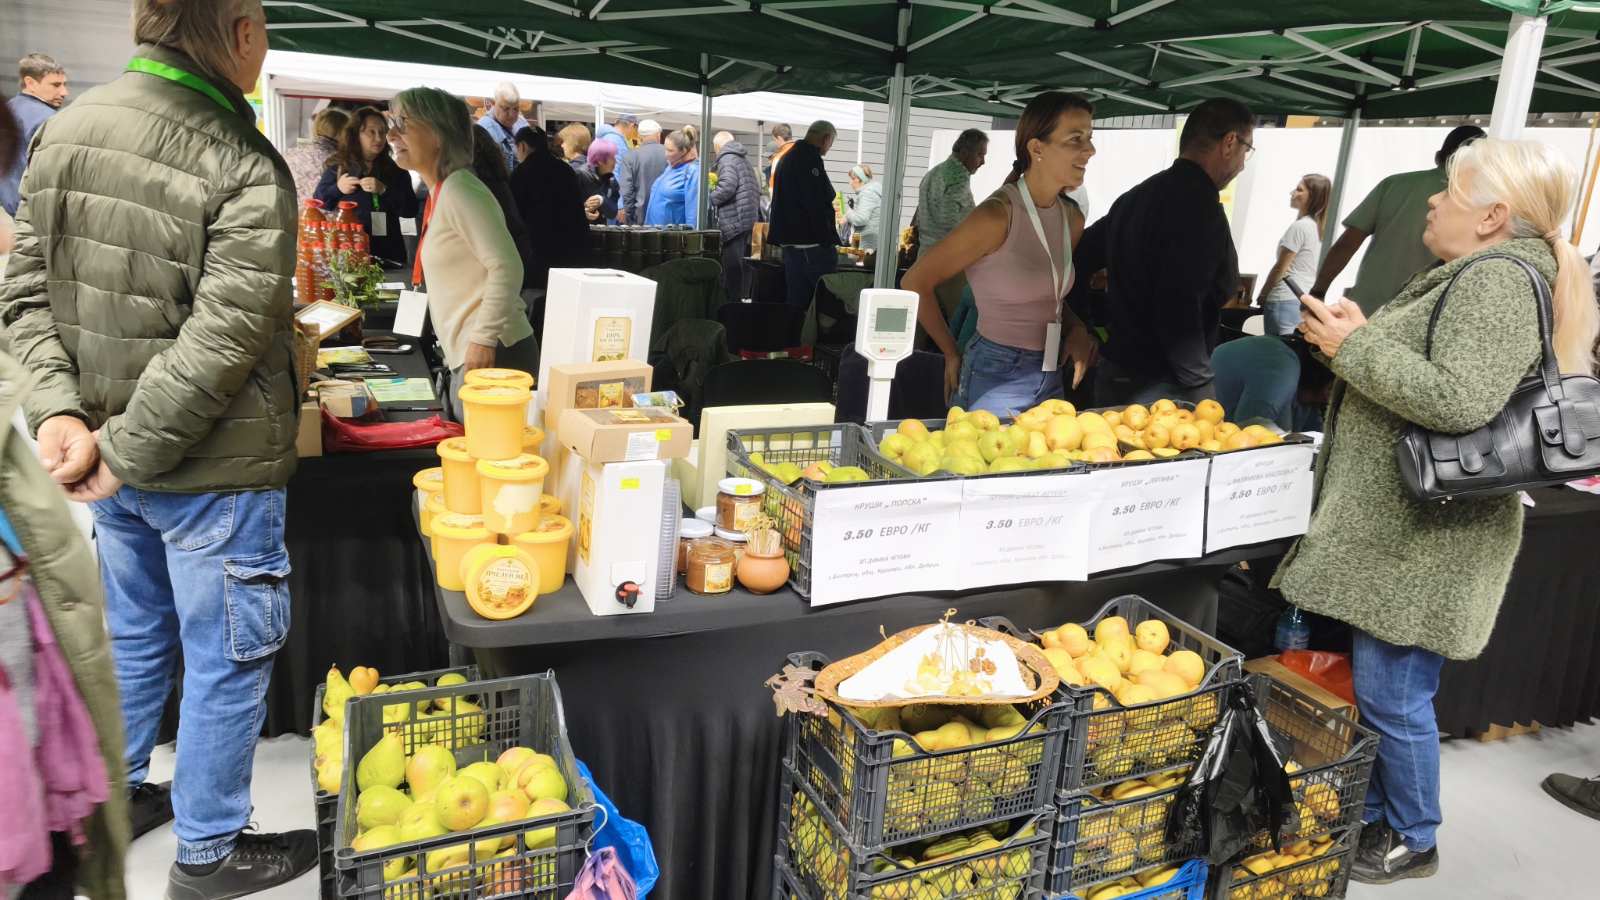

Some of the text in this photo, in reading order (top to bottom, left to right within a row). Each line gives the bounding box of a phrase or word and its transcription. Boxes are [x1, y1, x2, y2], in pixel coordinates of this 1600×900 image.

[1229, 489, 1252, 500] 3.50
[1256, 485, 1277, 496] ЕВРО
[1112, 504, 1136, 516] 3.50
[1139, 500, 1163, 511] ЕВРО
[985, 519, 1013, 530] 3.50
[1018, 516, 1044, 528] ЕВРО
[843, 522, 932, 541] 3.50 ЕВРО /КГ
